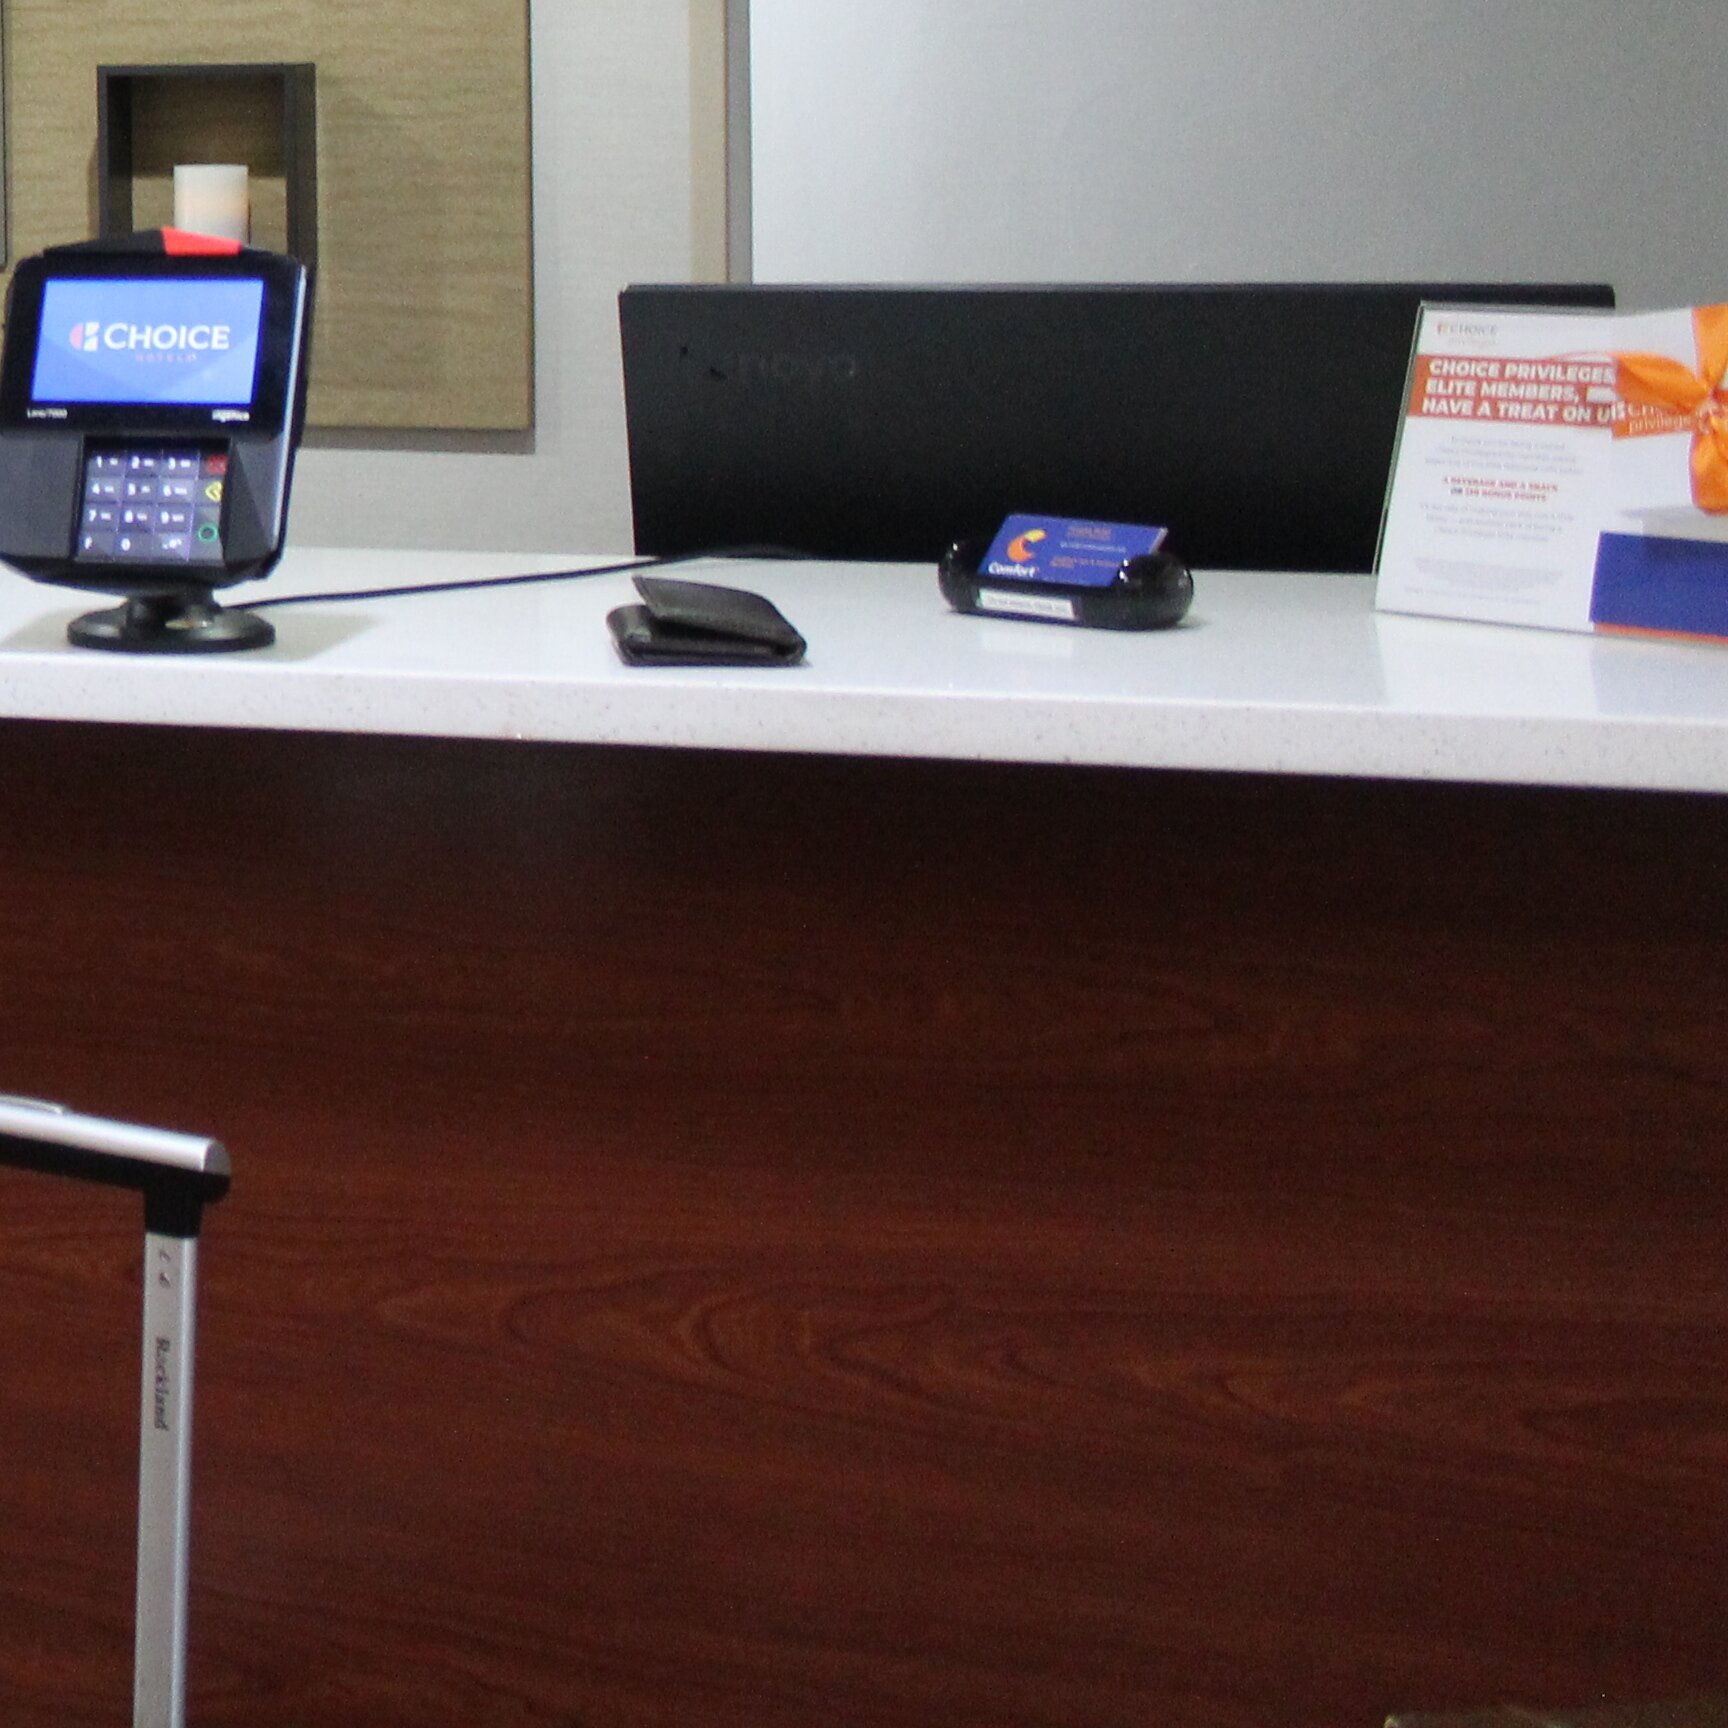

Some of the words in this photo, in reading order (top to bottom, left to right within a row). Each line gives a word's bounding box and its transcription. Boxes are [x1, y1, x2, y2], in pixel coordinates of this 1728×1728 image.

[103, 322, 231, 351] CHOICE
[1429, 359, 1500, 378] CHOICE
[1504, 362, 1616, 384] PRIVILEGES
[1425, 378, 1476, 397] ELITE
[1480, 380, 1579, 404] MEMBERS,
[1421, 397, 1473, 416] HAVE
[1478, 399, 1491, 417] A
[1498, 400, 1559, 420] TREAT
[1562, 403, 1591, 422] ON
[988, 560, 1036, 578] Comfort
